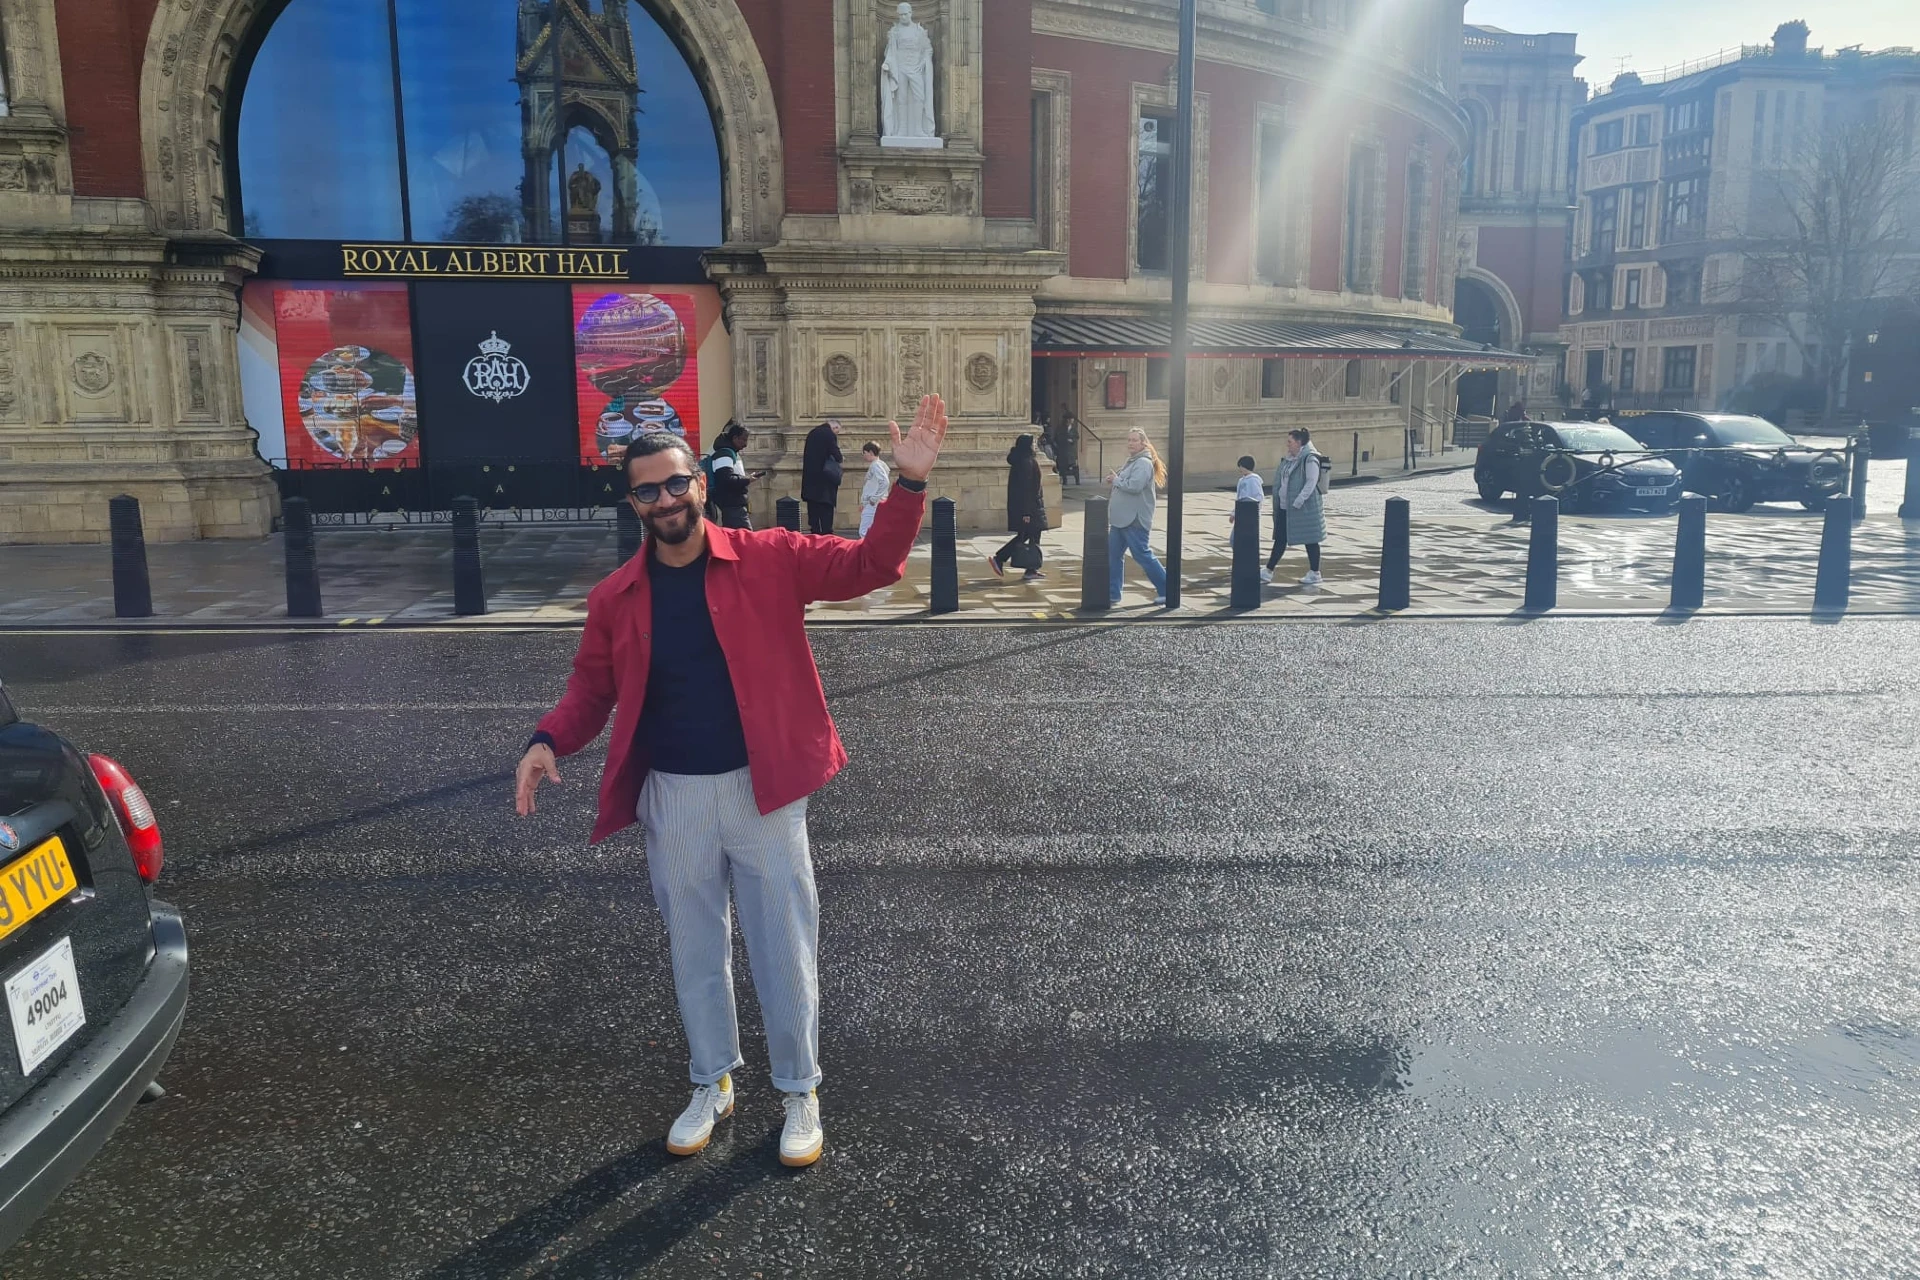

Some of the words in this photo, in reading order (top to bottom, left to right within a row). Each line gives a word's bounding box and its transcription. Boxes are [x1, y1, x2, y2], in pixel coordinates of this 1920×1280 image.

[341, 249, 438, 271] ROYAL
[444, 251, 550, 273] ALBERT
[556, 253, 629, 274] HALL
[9, 849, 64, 910] YYU
[27, 979, 67, 1026] 49004
